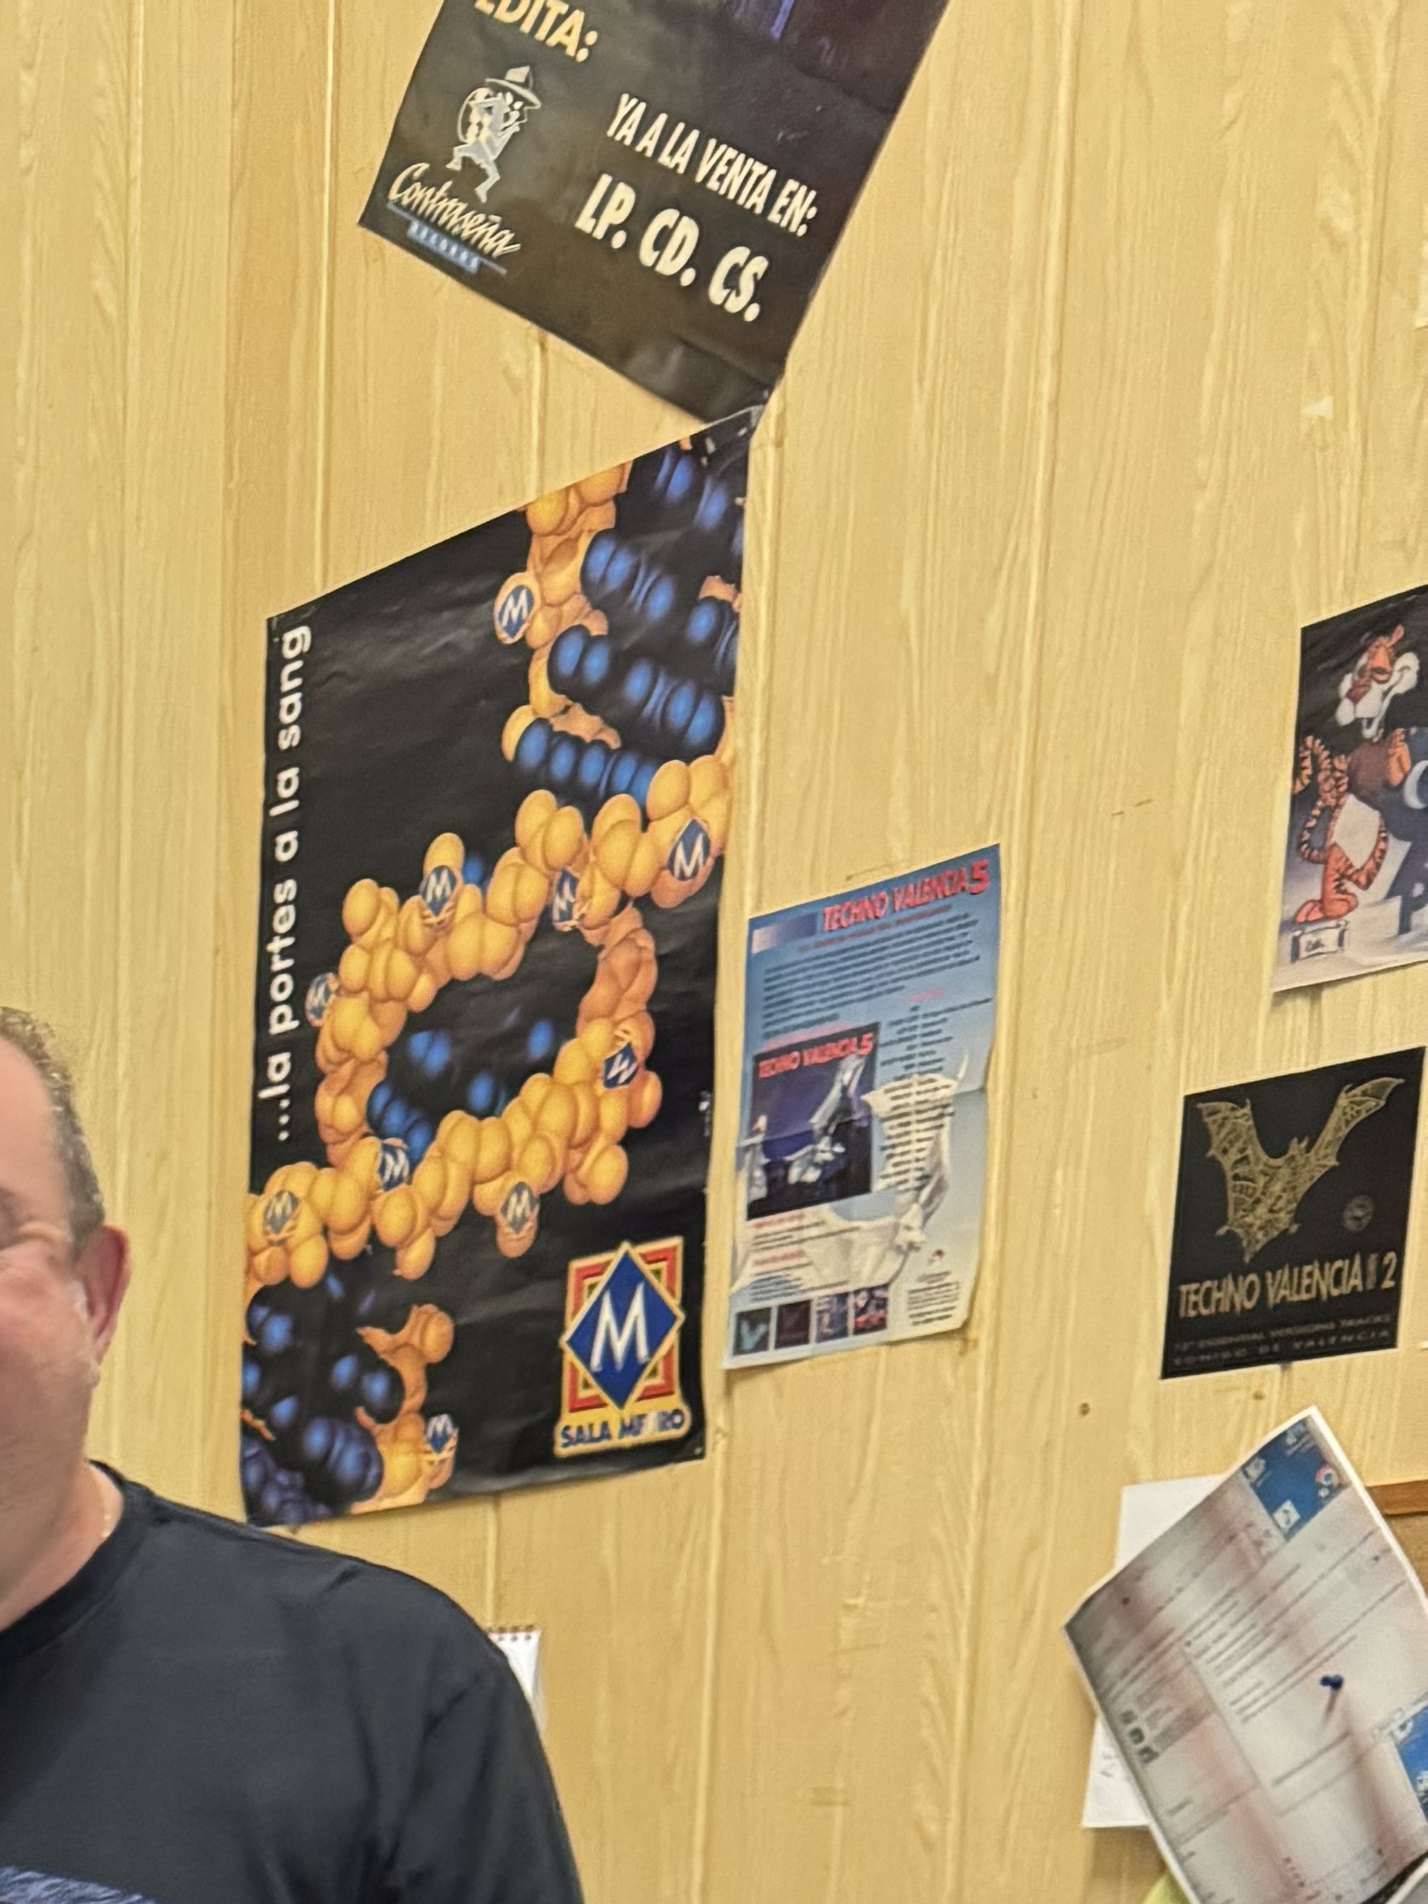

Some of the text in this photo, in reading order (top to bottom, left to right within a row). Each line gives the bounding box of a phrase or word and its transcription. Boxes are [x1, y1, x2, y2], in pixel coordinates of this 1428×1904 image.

[388, 162, 521, 259] Contraseña
[605, 93, 819, 238] YA A LA VENTA EN:
[575, 174, 769, 322] LP. CD. CS.
[277, 625, 312, 751] sang
[269, 766, 301, 818] la
[274, 829, 299, 863] a
[821, 890, 889, 933] TECHNO
[892, 865, 969, 914] VALENCIA
[969, 858, 991, 895] 5
[266, 876, 300, 1035] portes
[590, 1283, 650, 1373] M
[1177, 1271, 1262, 1319] TECHNO
[1264, 1250, 1364, 1310] VALENCIA
[1380, 1250, 1398, 1290] 2
[560, 1419, 612, 1448] SALA
